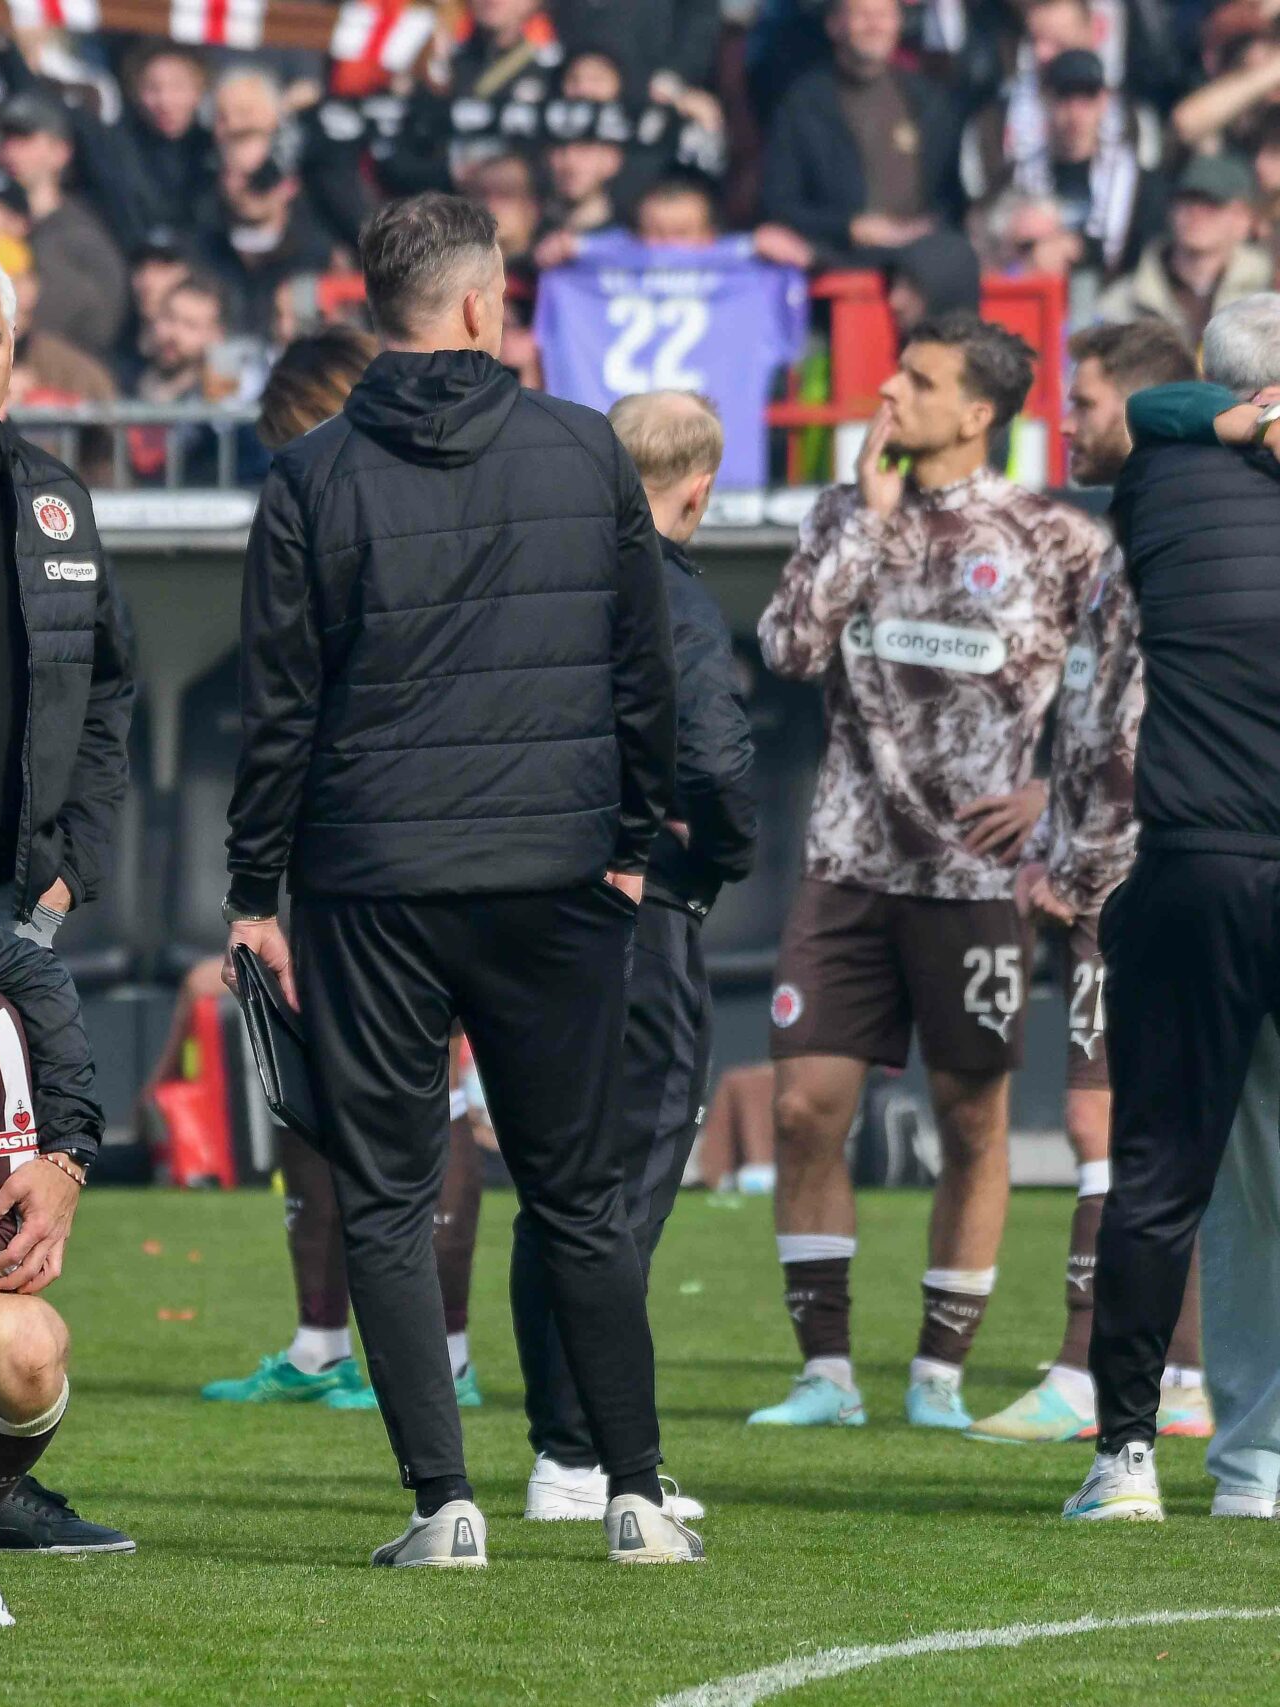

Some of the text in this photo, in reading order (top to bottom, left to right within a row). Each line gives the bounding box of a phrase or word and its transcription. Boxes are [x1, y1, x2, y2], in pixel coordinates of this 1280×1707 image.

[603, 298, 710, 393] 22
[63, 567, 93, 577] congstar
[886, 632, 990, 659] congstar
[963, 948, 1022, 1013] 25
